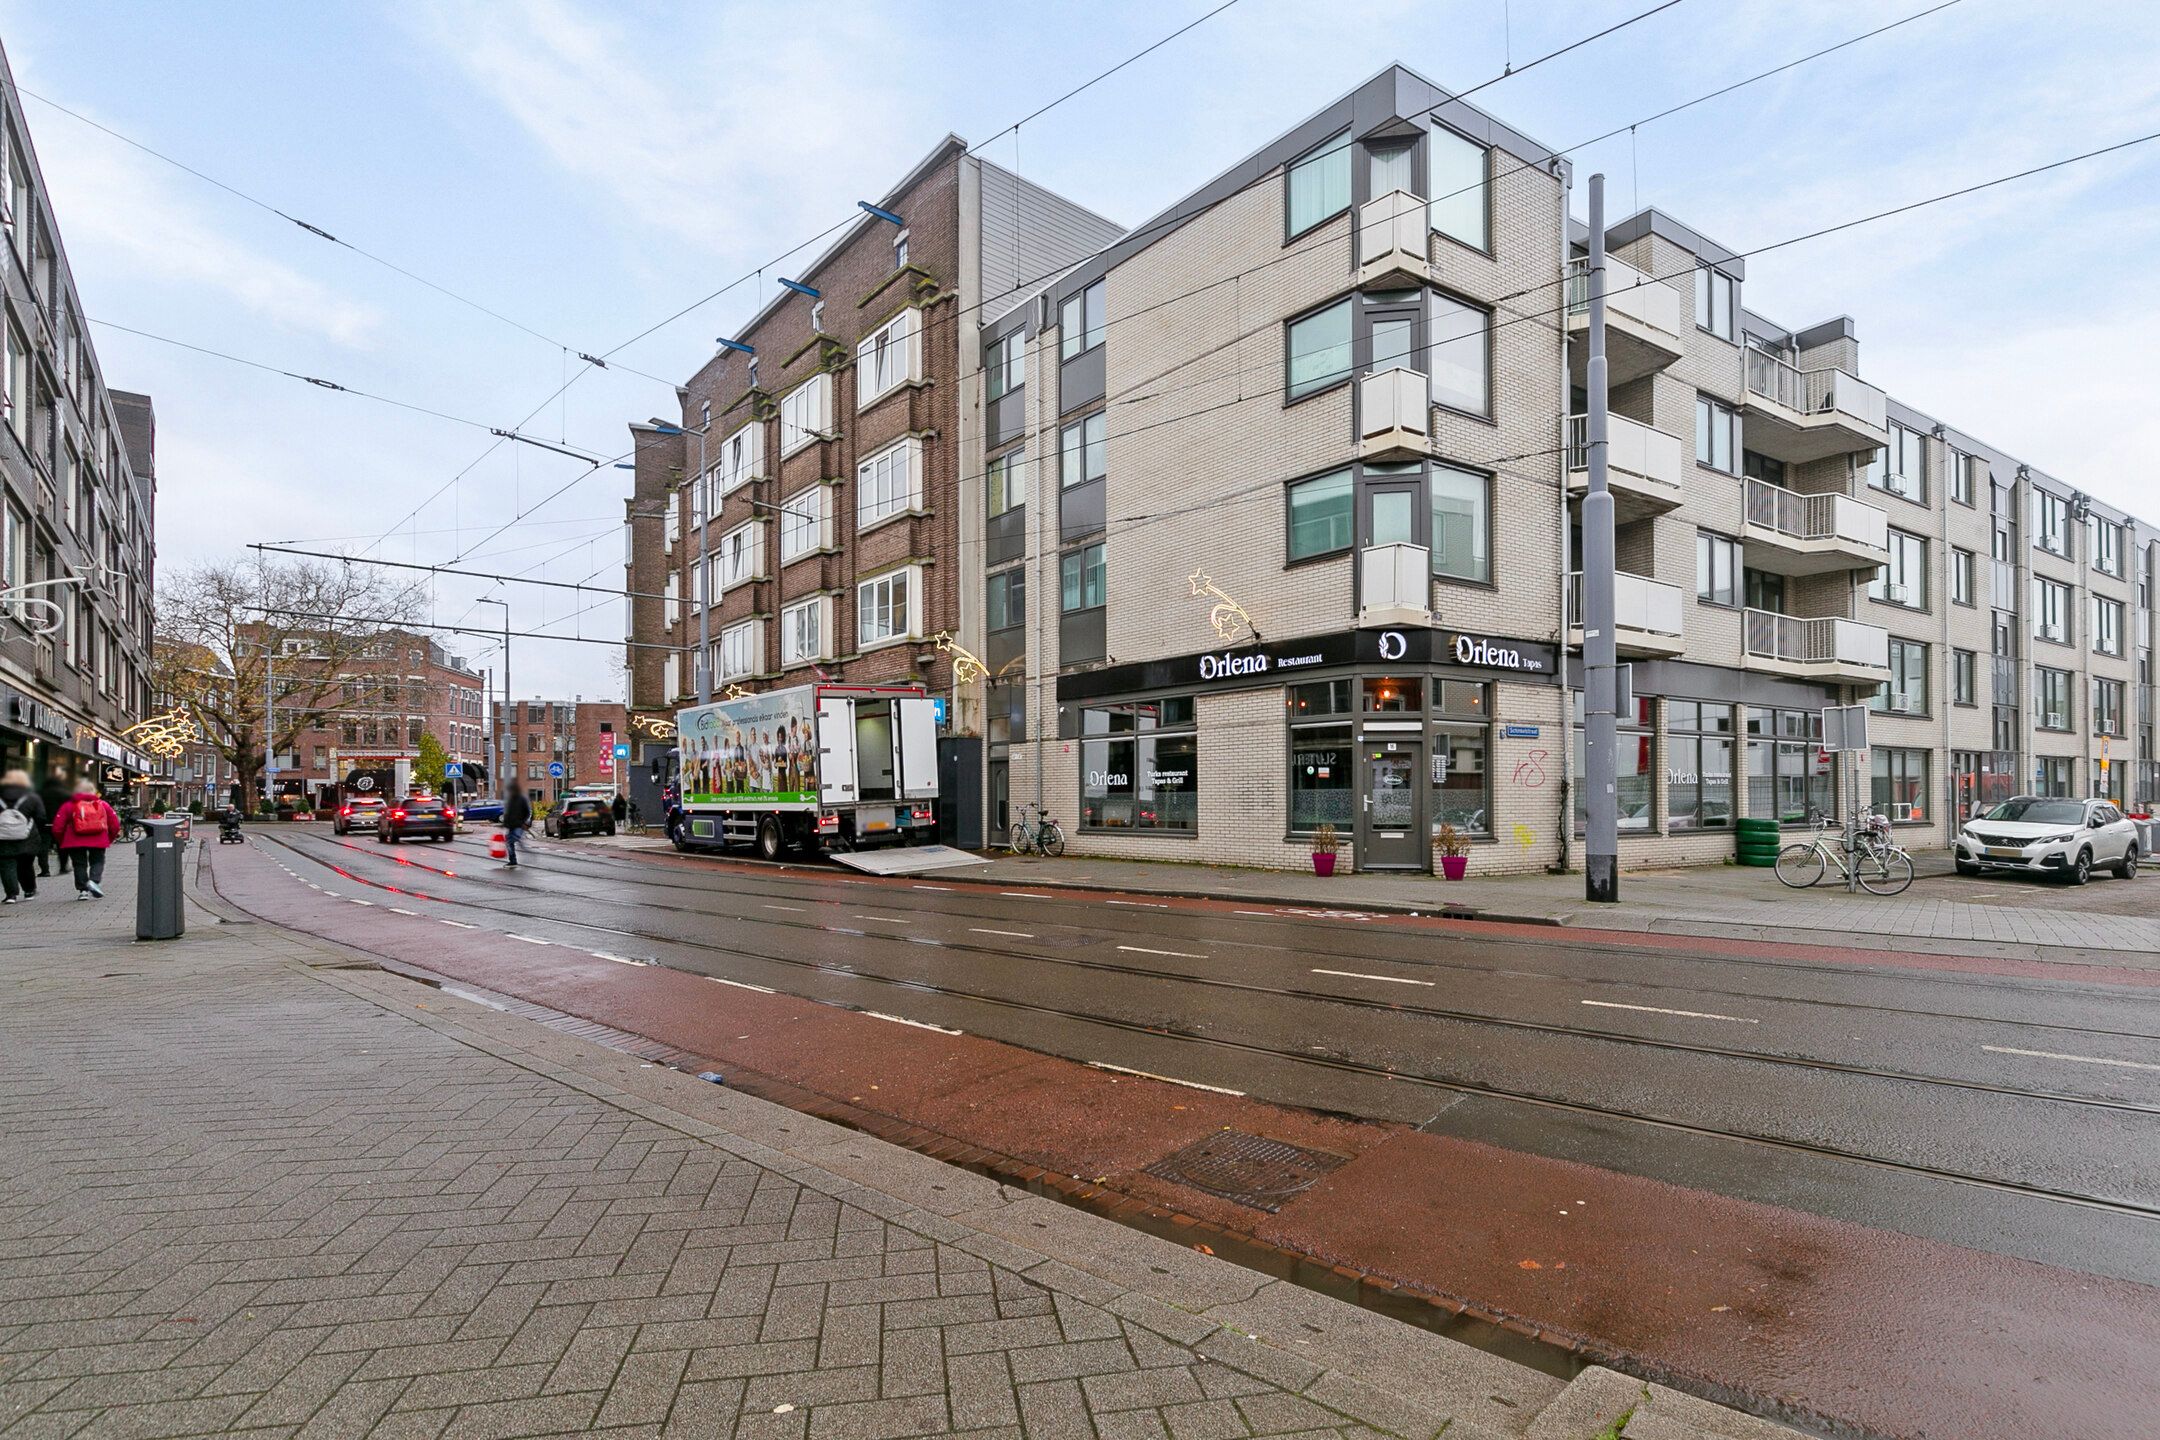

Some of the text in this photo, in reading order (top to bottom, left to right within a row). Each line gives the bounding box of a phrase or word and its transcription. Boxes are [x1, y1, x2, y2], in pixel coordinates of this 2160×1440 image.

[1199, 652, 1323, 679] Orlena Restaurant
[1456, 634, 1542, 670] Orlena Tapas
[1089, 770, 1128, 786] Orlena
